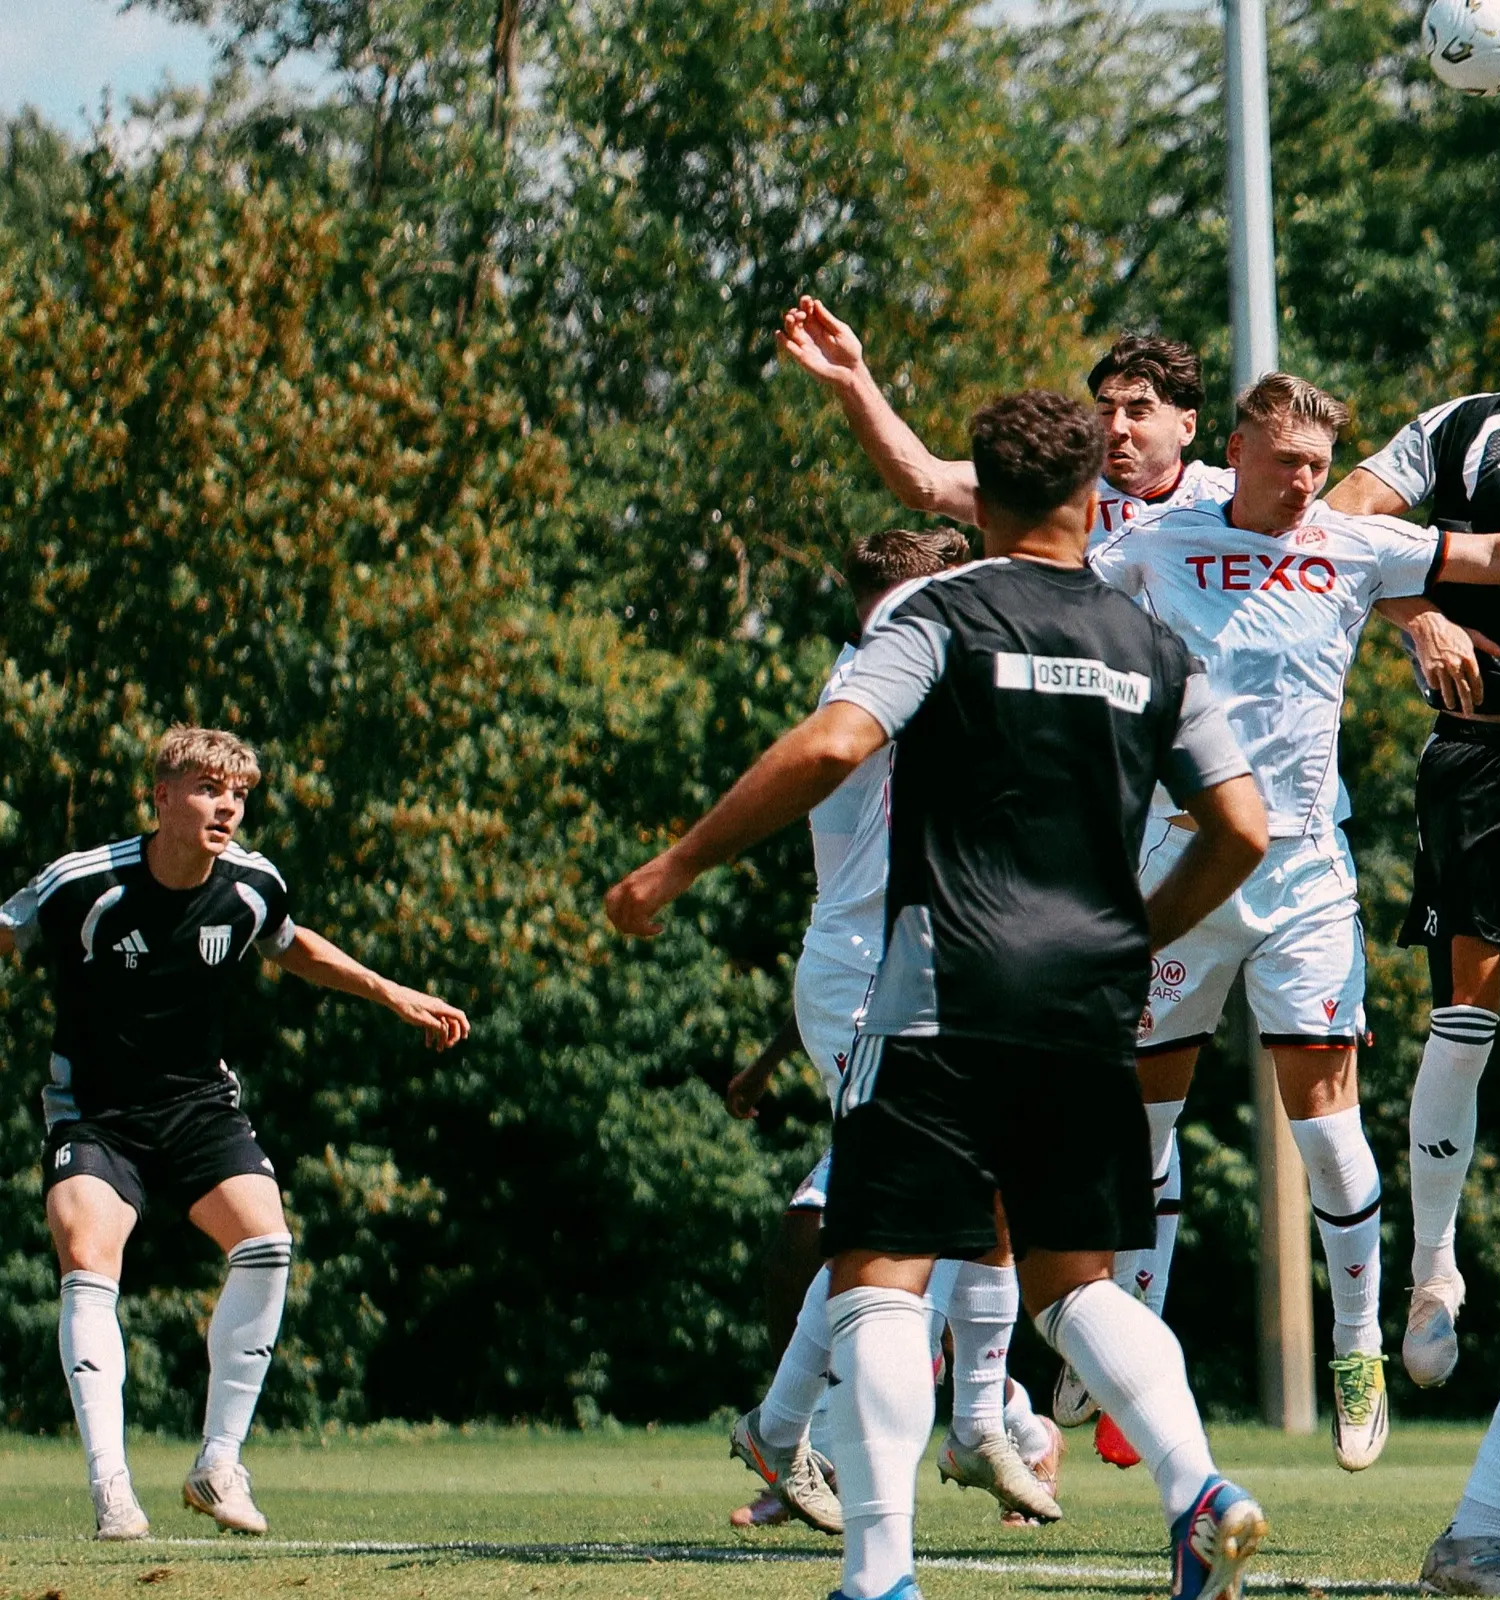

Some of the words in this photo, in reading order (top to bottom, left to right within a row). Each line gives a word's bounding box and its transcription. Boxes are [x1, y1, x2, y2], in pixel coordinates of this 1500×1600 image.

[1185, 553, 1337, 595] TEXO
[1423, 905, 1438, 937] 13
[125, 953, 138, 969] 16
[1149, 986, 1182, 1003] ARS
[55, 1143, 71, 1170] 16
